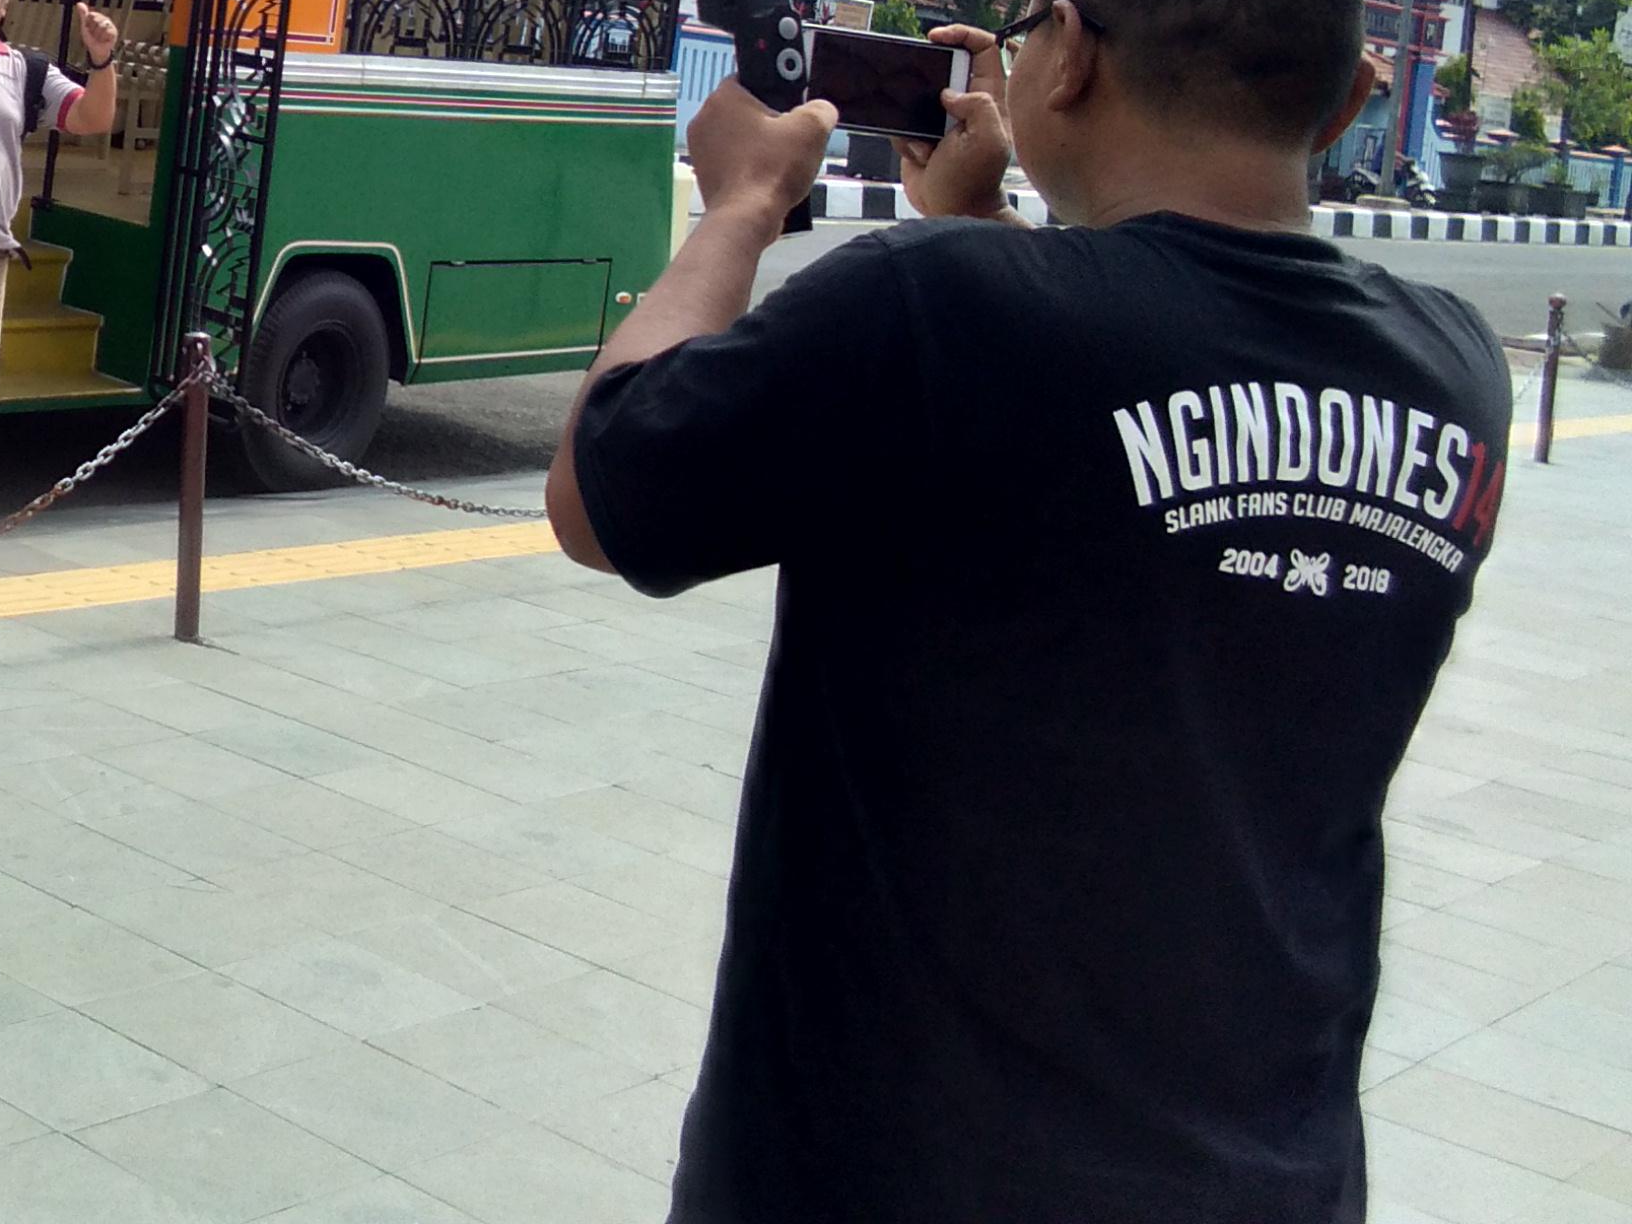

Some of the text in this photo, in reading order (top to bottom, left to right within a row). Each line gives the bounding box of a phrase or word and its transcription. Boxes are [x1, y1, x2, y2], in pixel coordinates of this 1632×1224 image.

[1165, 492, 1464, 573] SLANK FANS CLUB MAJALENGKA
[1218, 548, 1391, 593] 2004 2018
